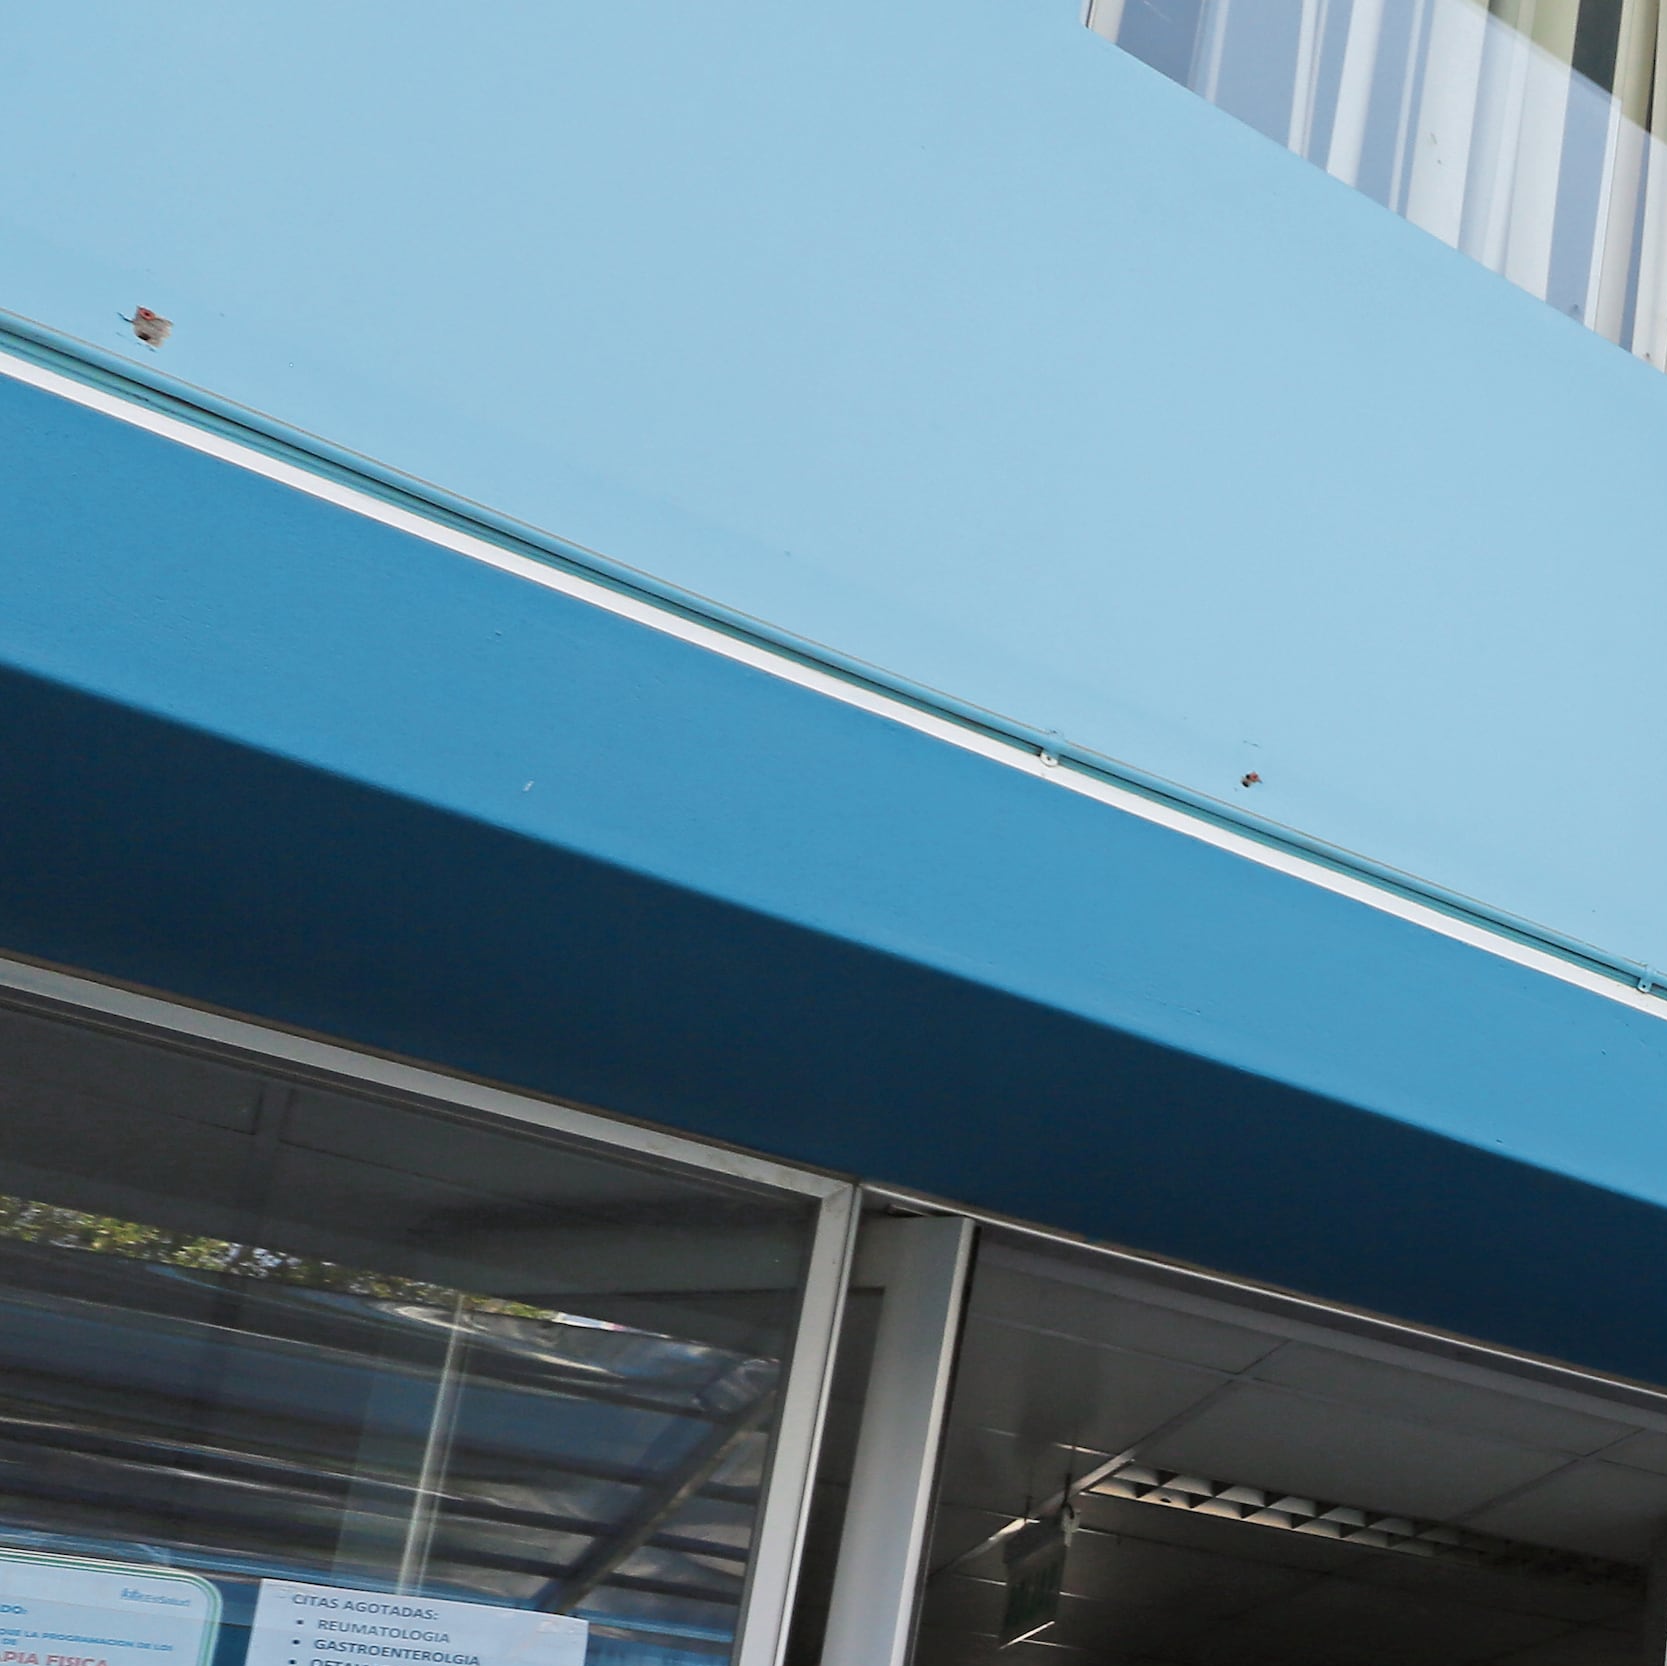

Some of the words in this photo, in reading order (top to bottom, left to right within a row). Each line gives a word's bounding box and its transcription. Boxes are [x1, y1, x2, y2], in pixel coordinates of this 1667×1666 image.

[292, 1593, 339, 1609] CITAS
[343, 1600, 439, 1620] AGOTADAS:
[317, 1618, 450, 1644] REUMATOLOGIA
[0, 1651, 39, 1666] PIA
[314, 1638, 481, 1666] GASTROENTEROLGIA
